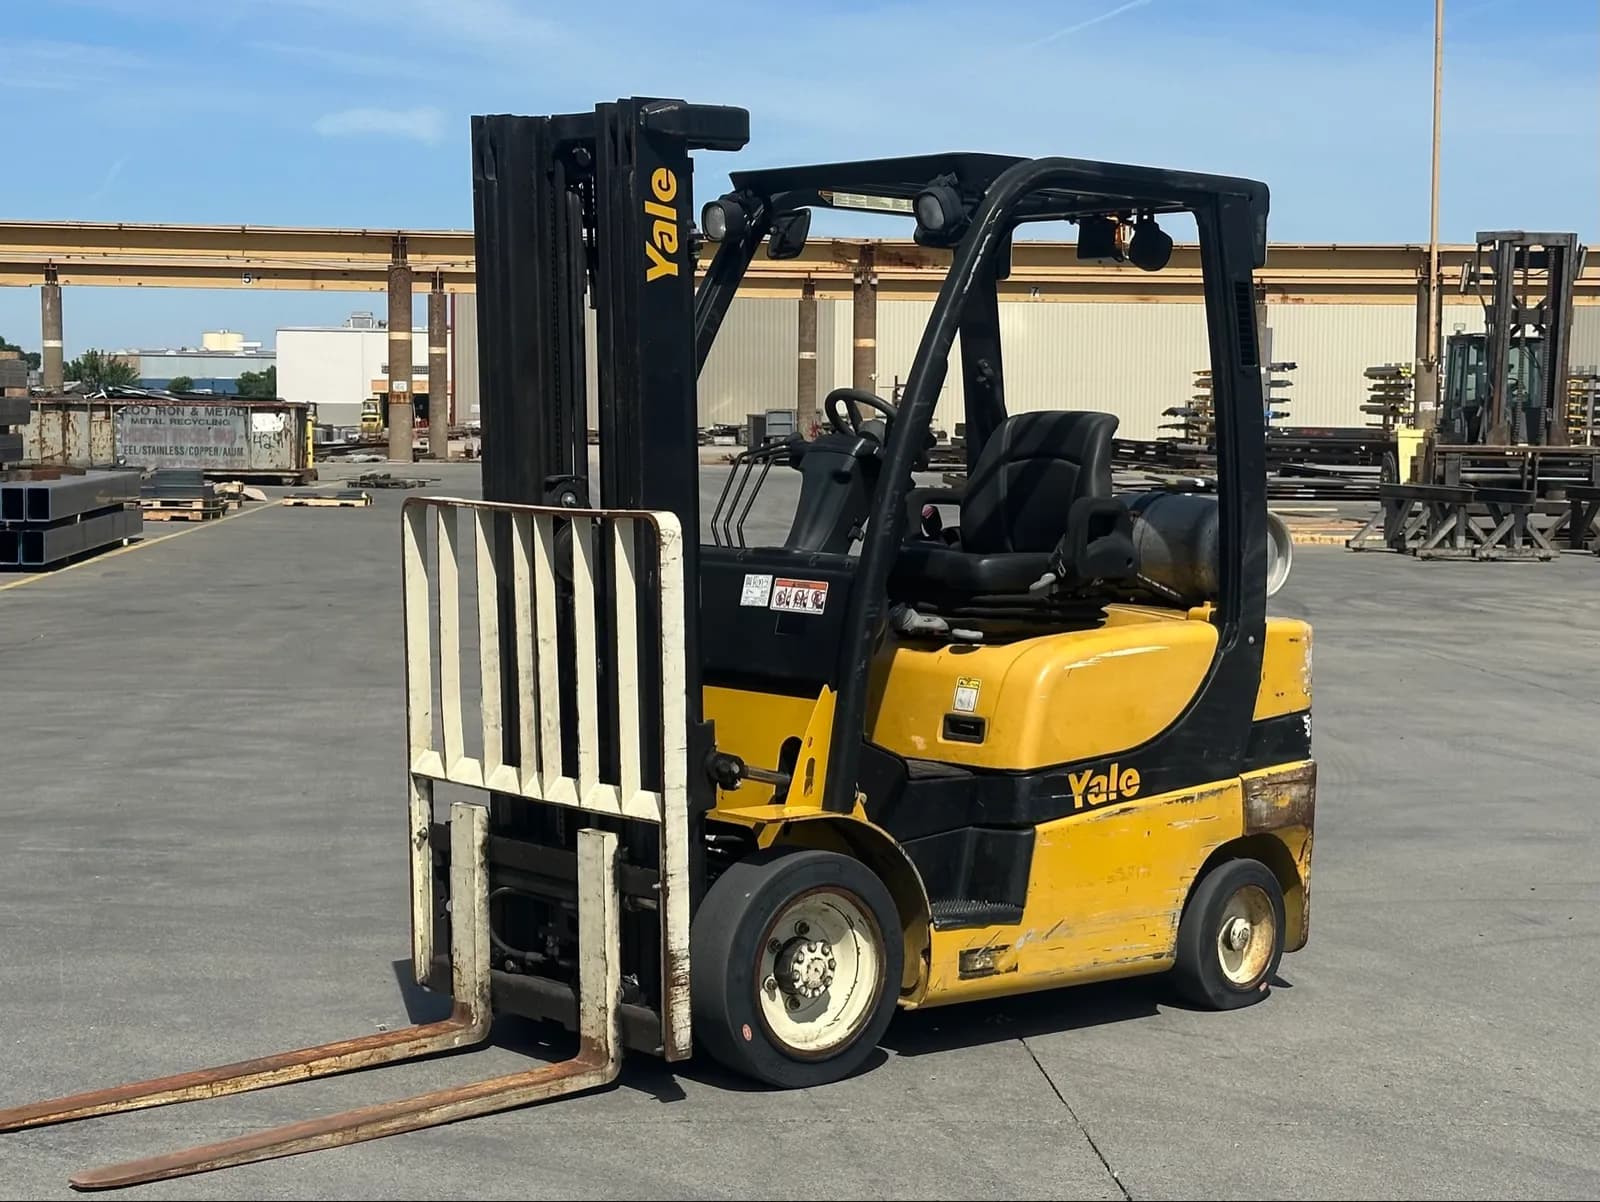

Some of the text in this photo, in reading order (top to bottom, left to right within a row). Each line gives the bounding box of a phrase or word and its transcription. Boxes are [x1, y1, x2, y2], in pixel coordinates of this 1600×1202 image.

[644, 168, 678, 282] Yale
[243, 272, 252, 283] 5
[1031, 286, 1040, 297] 7
[155, 406, 185, 416] IRON
[191, 407, 199, 416] &
[205, 407, 244, 417] METAL
[170, 418, 231, 426] RECYCLING
[1068, 763, 1141, 809] Yale
